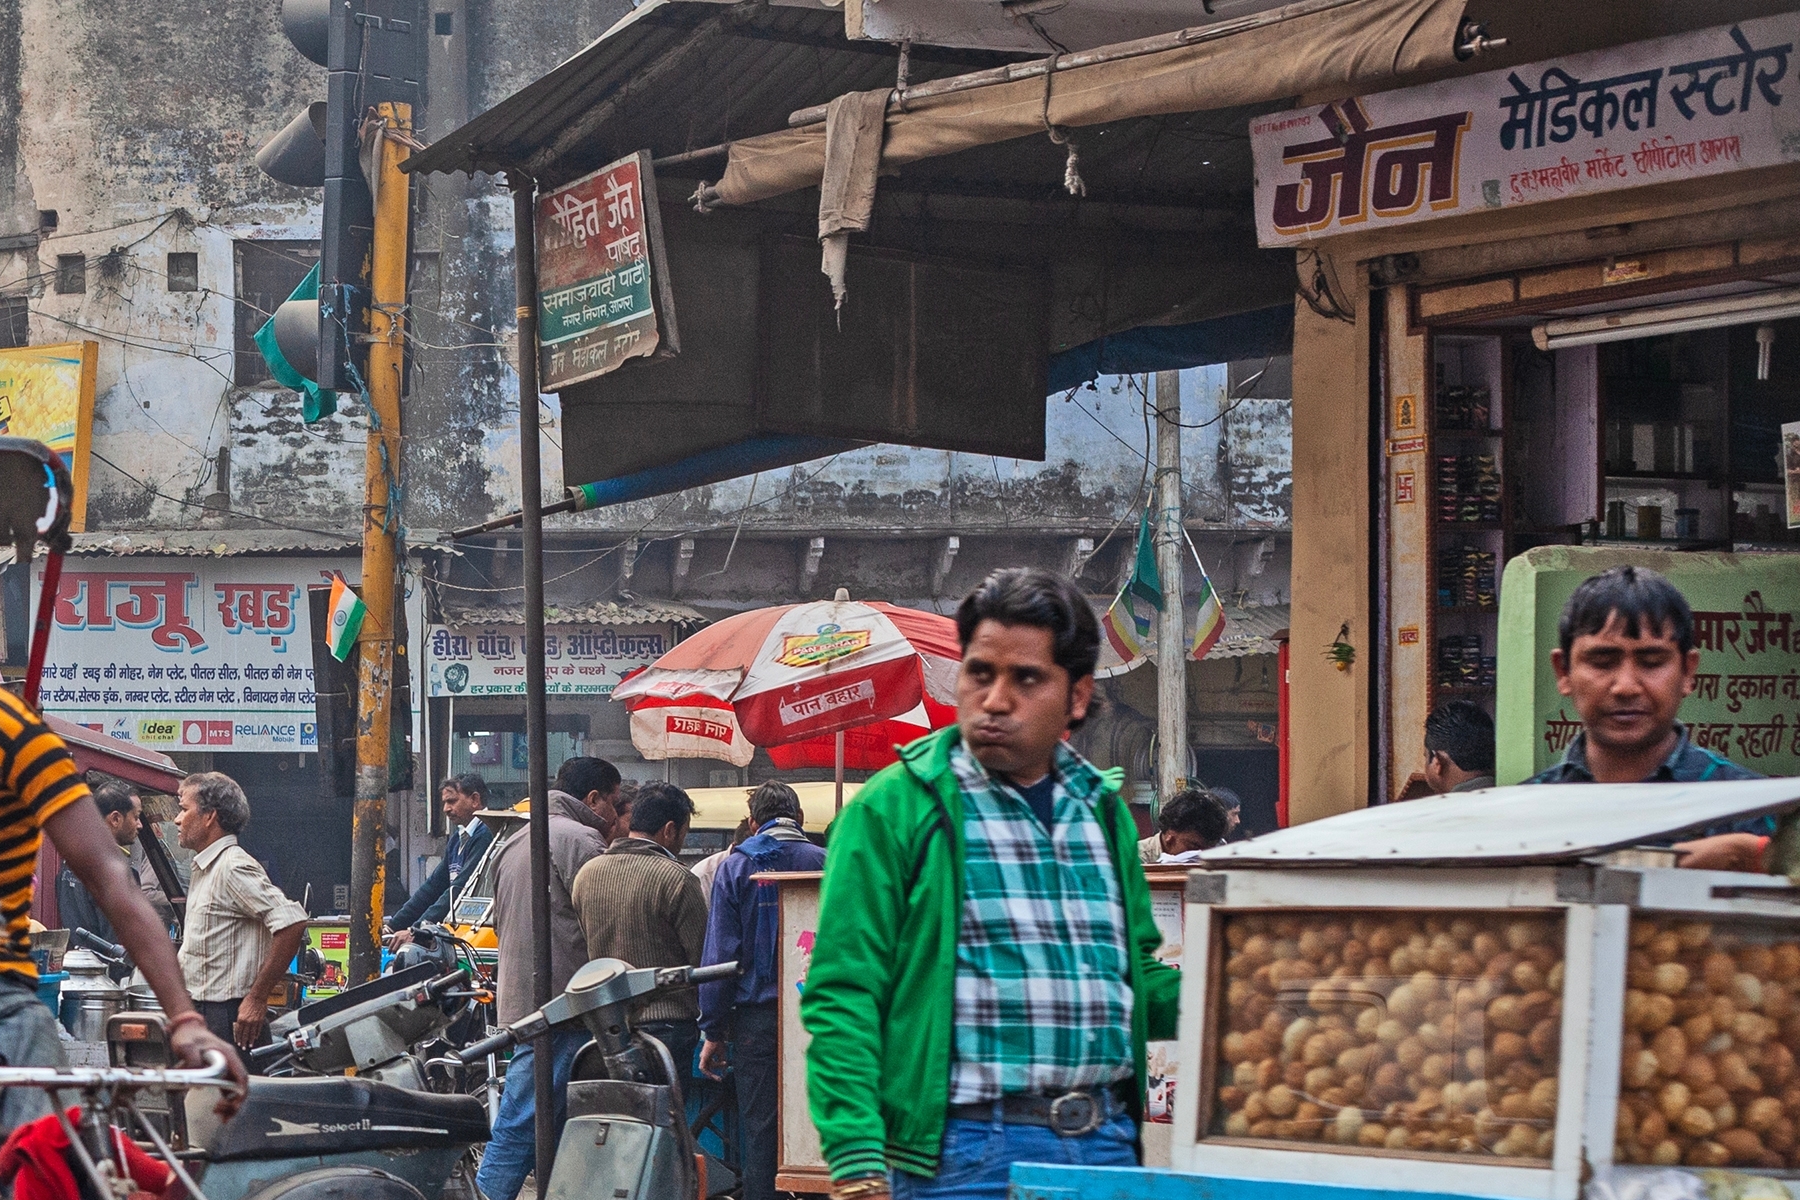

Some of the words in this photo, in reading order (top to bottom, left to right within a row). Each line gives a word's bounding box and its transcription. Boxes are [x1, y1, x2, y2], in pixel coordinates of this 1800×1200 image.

[1499, 67, 1664, 151] मेडिकल
[1668, 24, 1793, 120] स्टोर
[1273, 97, 1473, 235] जैन
[1700, 136, 1741, 164] आगरा
[603, 173, 635, 229] जैन
[543, 268, 616, 313] समाजवादी
[619, 255, 645, 287] पार्टी
[214, 583, 299, 653] रबड़
[1744, 590, 1794, 653] जैन
[432, 629, 470, 658] हीरा
[41, 663, 57, 679] मारे
[60, 662, 78, 680] यहाँ
[82, 667, 101, 683] रबड़
[104, 662, 116, 679] की
[148, 664, 163, 679] नेम
[191, 663, 216, 680] पीतल
[244, 663, 269, 680] पीतल
[271, 663, 284, 680] की
[287, 664, 302, 680] नेम
[493, 666, 525, 676] नजर
[562, 663, 575, 676] के
[125, 688, 149, 703] नम्बर
[174, 686, 197, 704] स्टील
[199, 688, 214, 703] नेम
[243, 686, 279, 704] विनायल
[280, 687, 296, 704] नेम
[470, 684, 484, 694] हर
[486, 684, 512, 695] प्रकार
[562, 681, 572, 693] के
[793, 697, 823, 717] पान
[826, 685, 862, 709] बहार
[1727, 674, 1777, 712] दुकान
[209, 729, 231, 738] MTS
[1697, 722, 1734, 756] बन्द
[1737, 713, 1788, 758] रहती
[321, 1121, 361, 1134] Select
